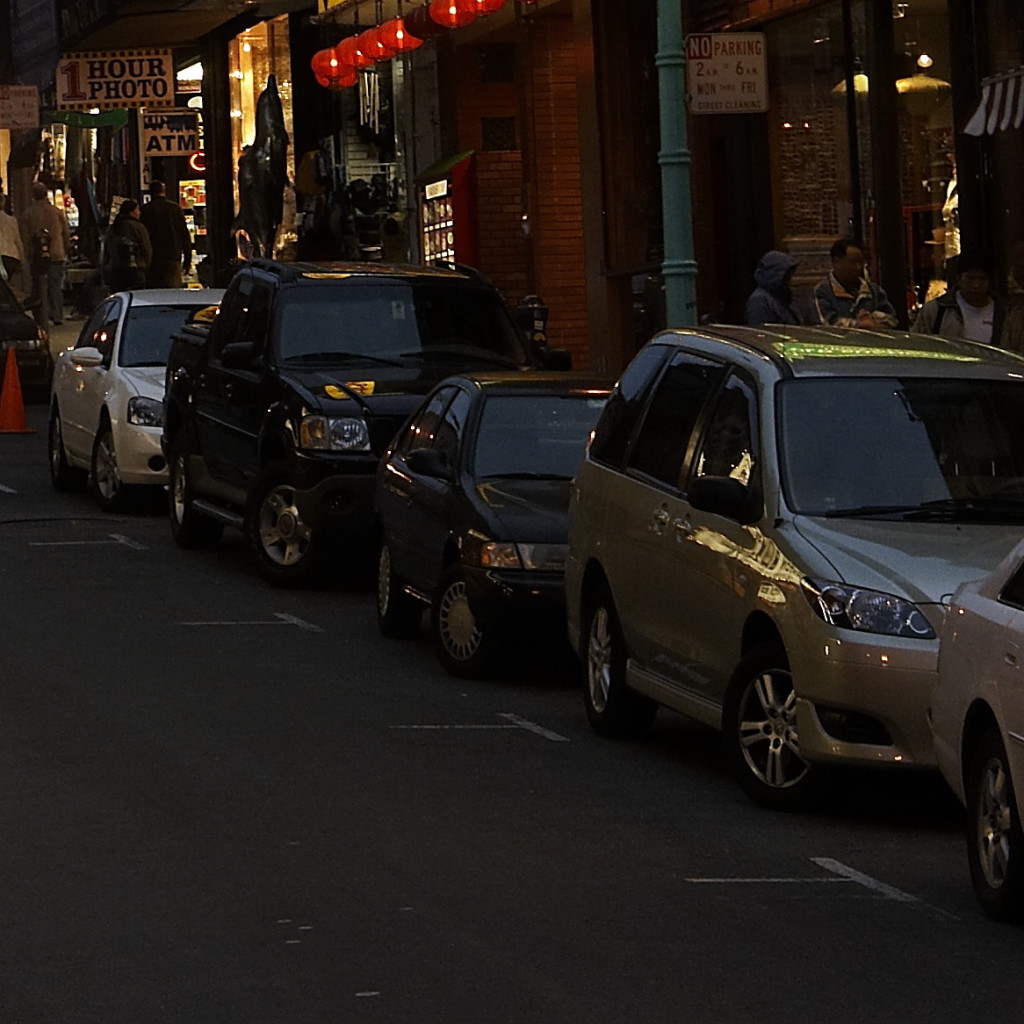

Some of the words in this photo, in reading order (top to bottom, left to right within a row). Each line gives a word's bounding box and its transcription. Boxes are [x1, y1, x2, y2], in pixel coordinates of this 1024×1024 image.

[689, 37, 711, 57] NO
[714, 40, 762, 56] PARKING
[61, 61, 87, 102] 1
[87, 58, 166, 79] HOUR
[88, 78, 169, 101] PHOTO
[741, 81, 757, 94] FRI
[146, 135, 196, 151] ATM
